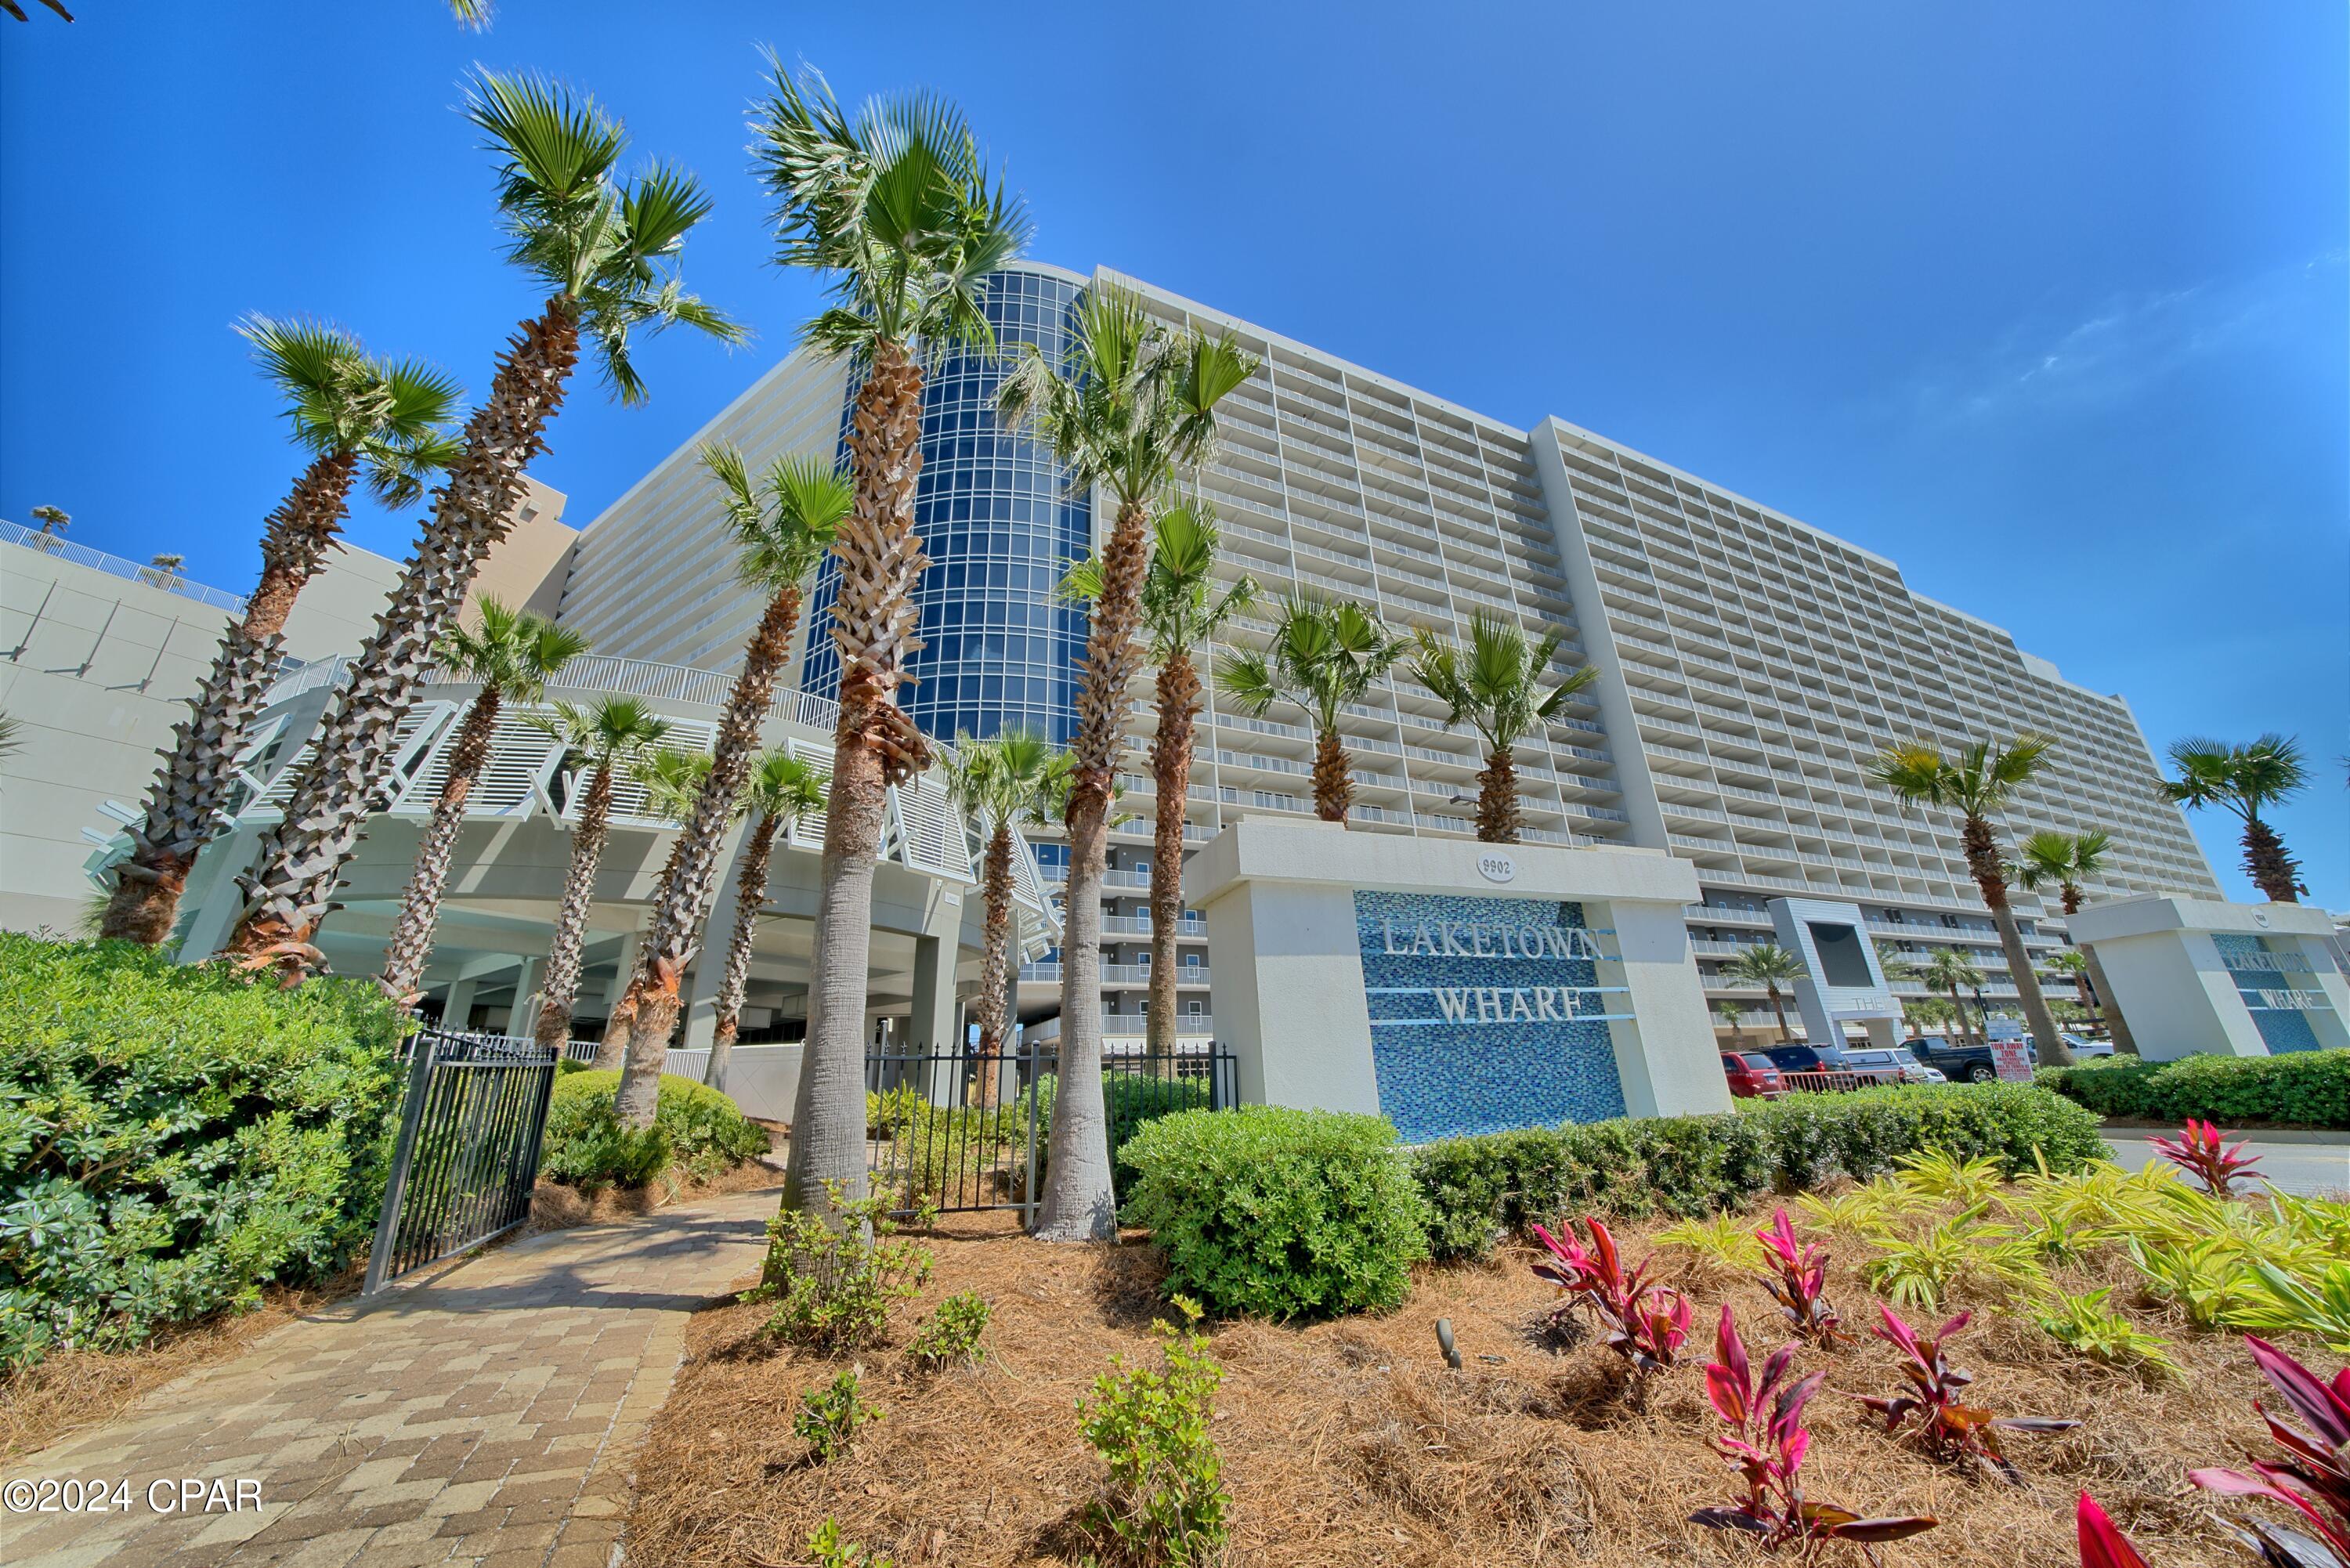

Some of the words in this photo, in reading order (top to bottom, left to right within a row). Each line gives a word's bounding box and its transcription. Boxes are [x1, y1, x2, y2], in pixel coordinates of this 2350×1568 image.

[1483, 858, 1510, 874] 9902
[1379, 918, 1604, 959] LAKETOWN
[2227, 951, 2309, 972] LAKETOWN
[1431, 986, 1581, 1024] WHARF
[1851, 996, 1884, 1010] THE
[2258, 989, 2313, 1010] WHARF
